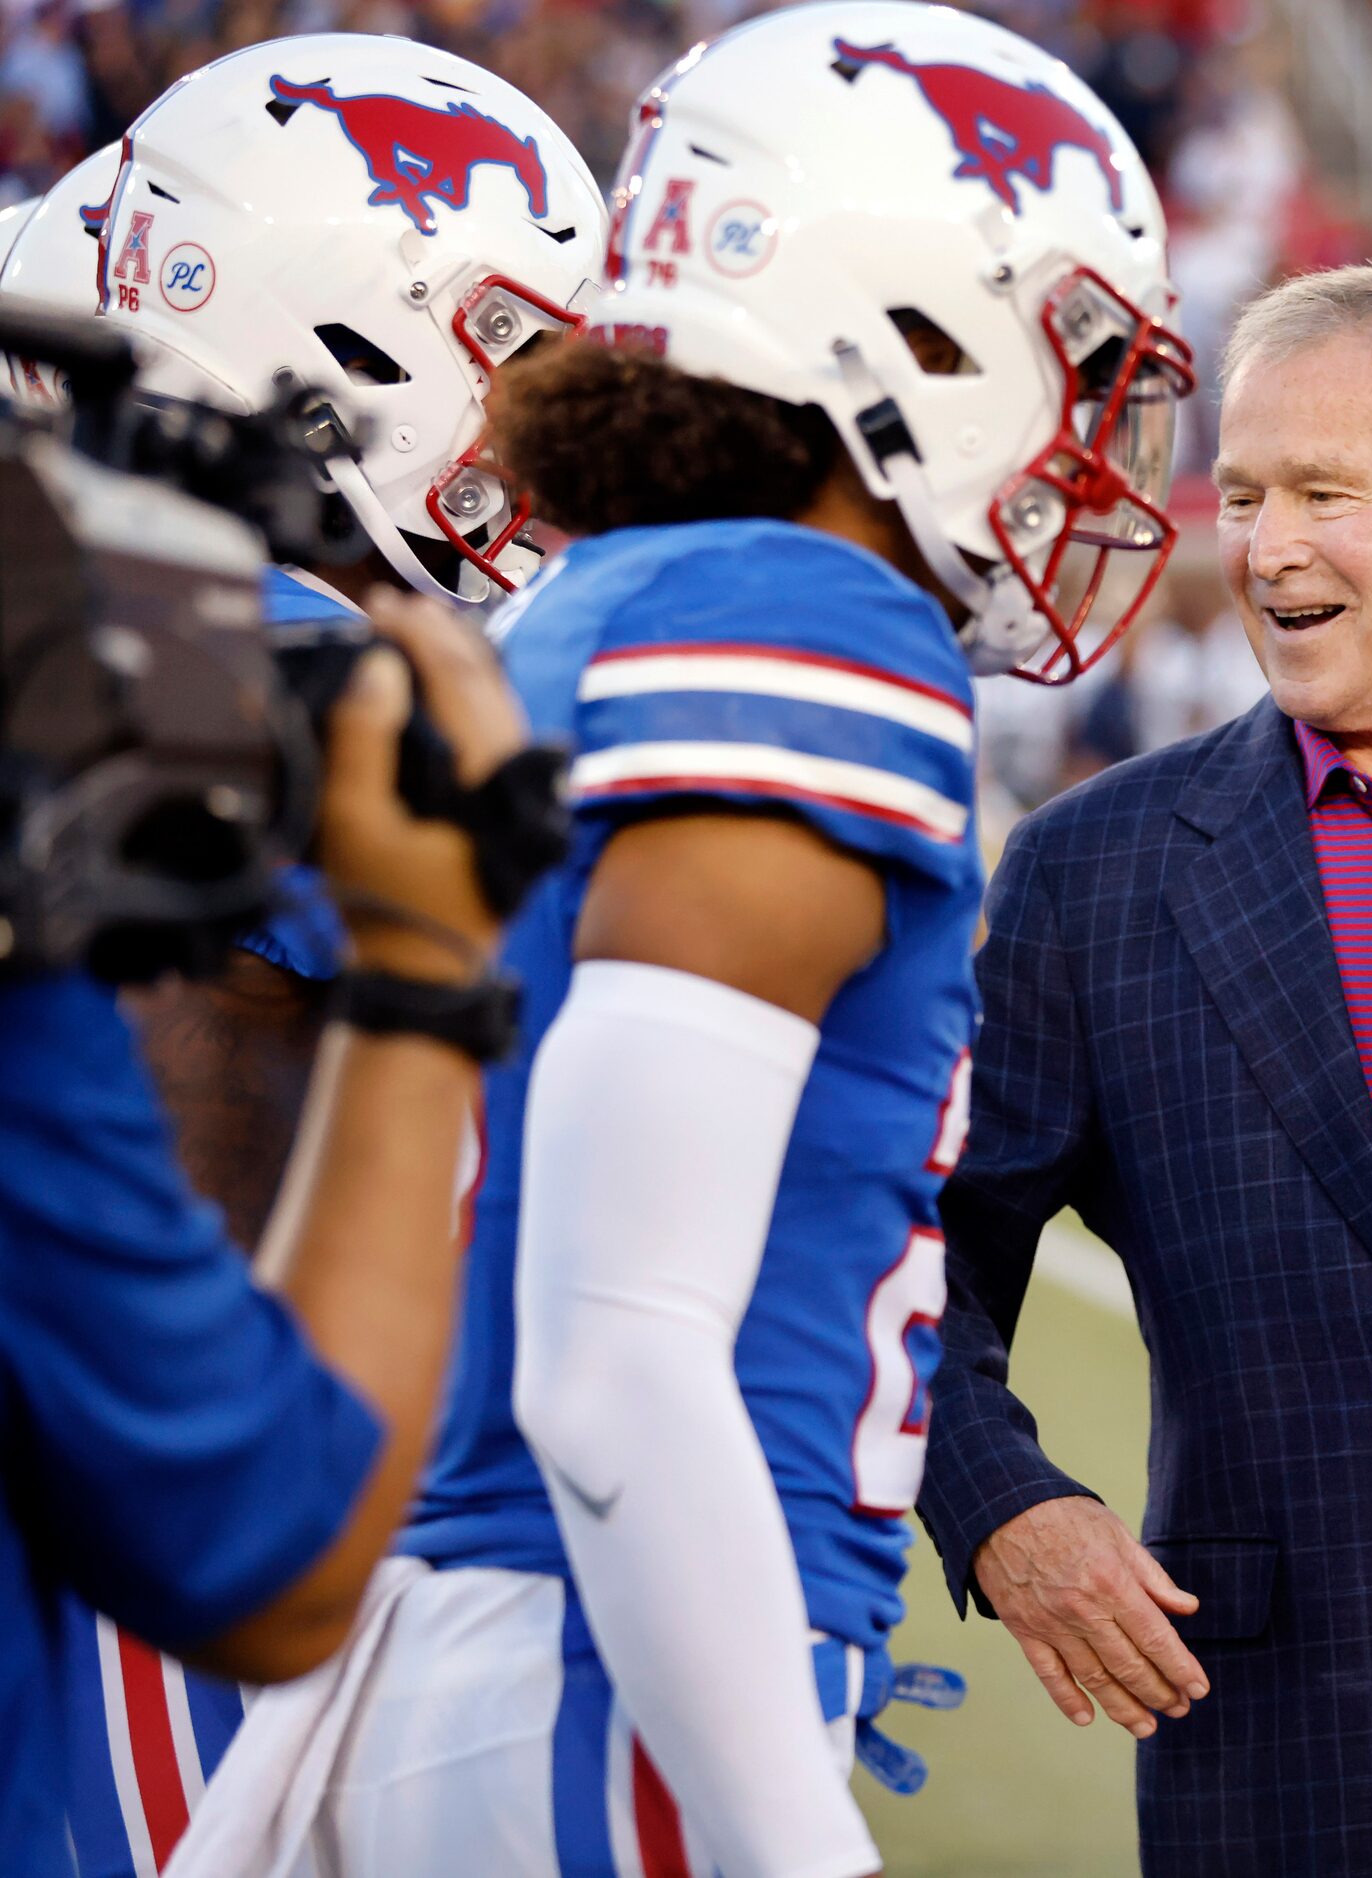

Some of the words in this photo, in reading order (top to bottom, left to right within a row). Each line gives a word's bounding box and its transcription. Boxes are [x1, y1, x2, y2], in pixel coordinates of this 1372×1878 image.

[643, 179, 695, 254] A
[114, 210, 154, 284] A
[118, 284, 140, 312] P6
[166, 262, 205, 291] PL
